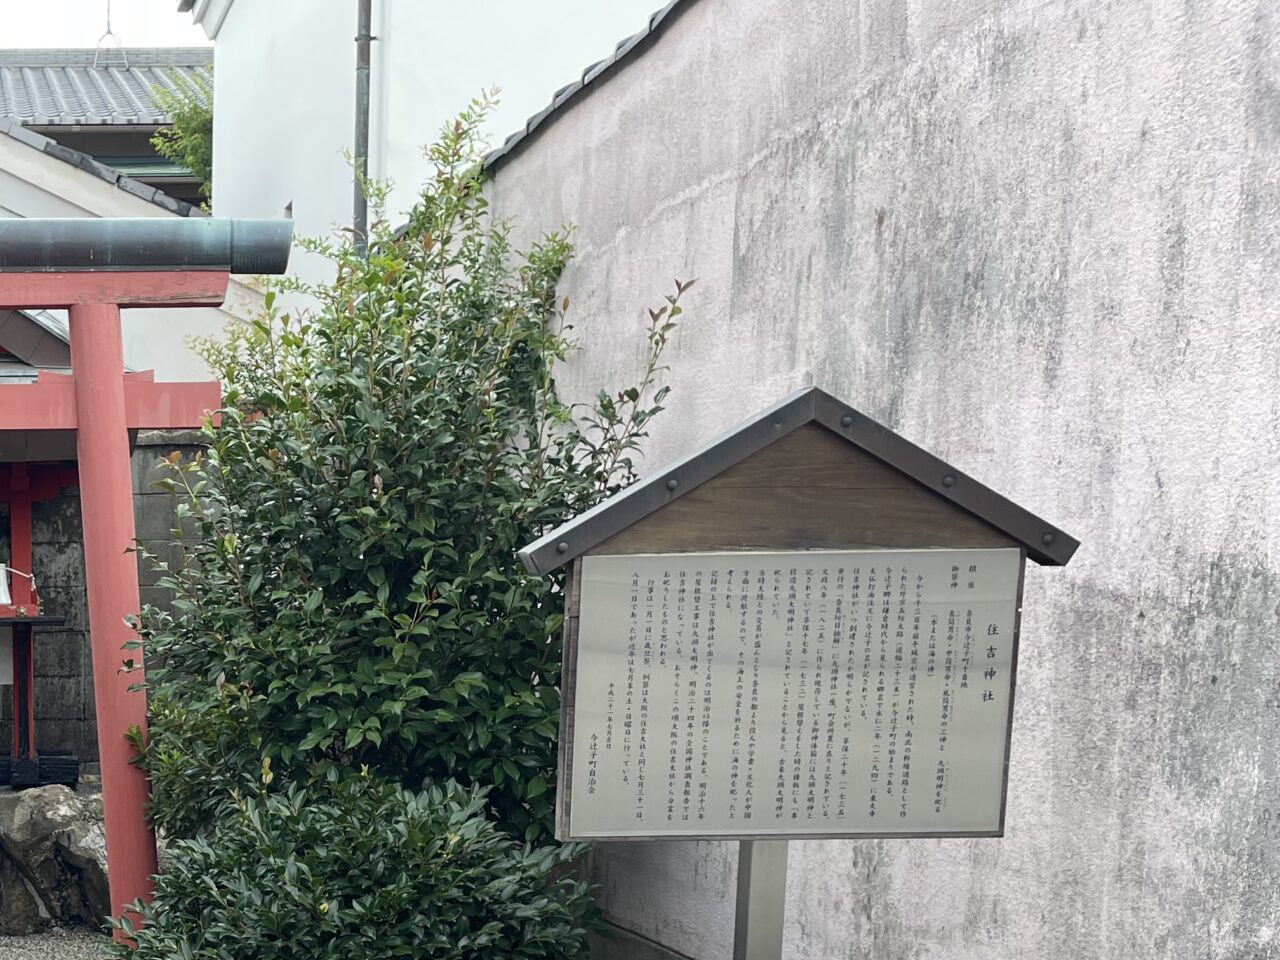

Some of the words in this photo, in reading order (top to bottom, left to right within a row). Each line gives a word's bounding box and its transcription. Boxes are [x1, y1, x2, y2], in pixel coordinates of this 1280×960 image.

[981, 623, 1000, 703] 住吉神社
[587, 733, 599, 795] 今辻子町自治会
